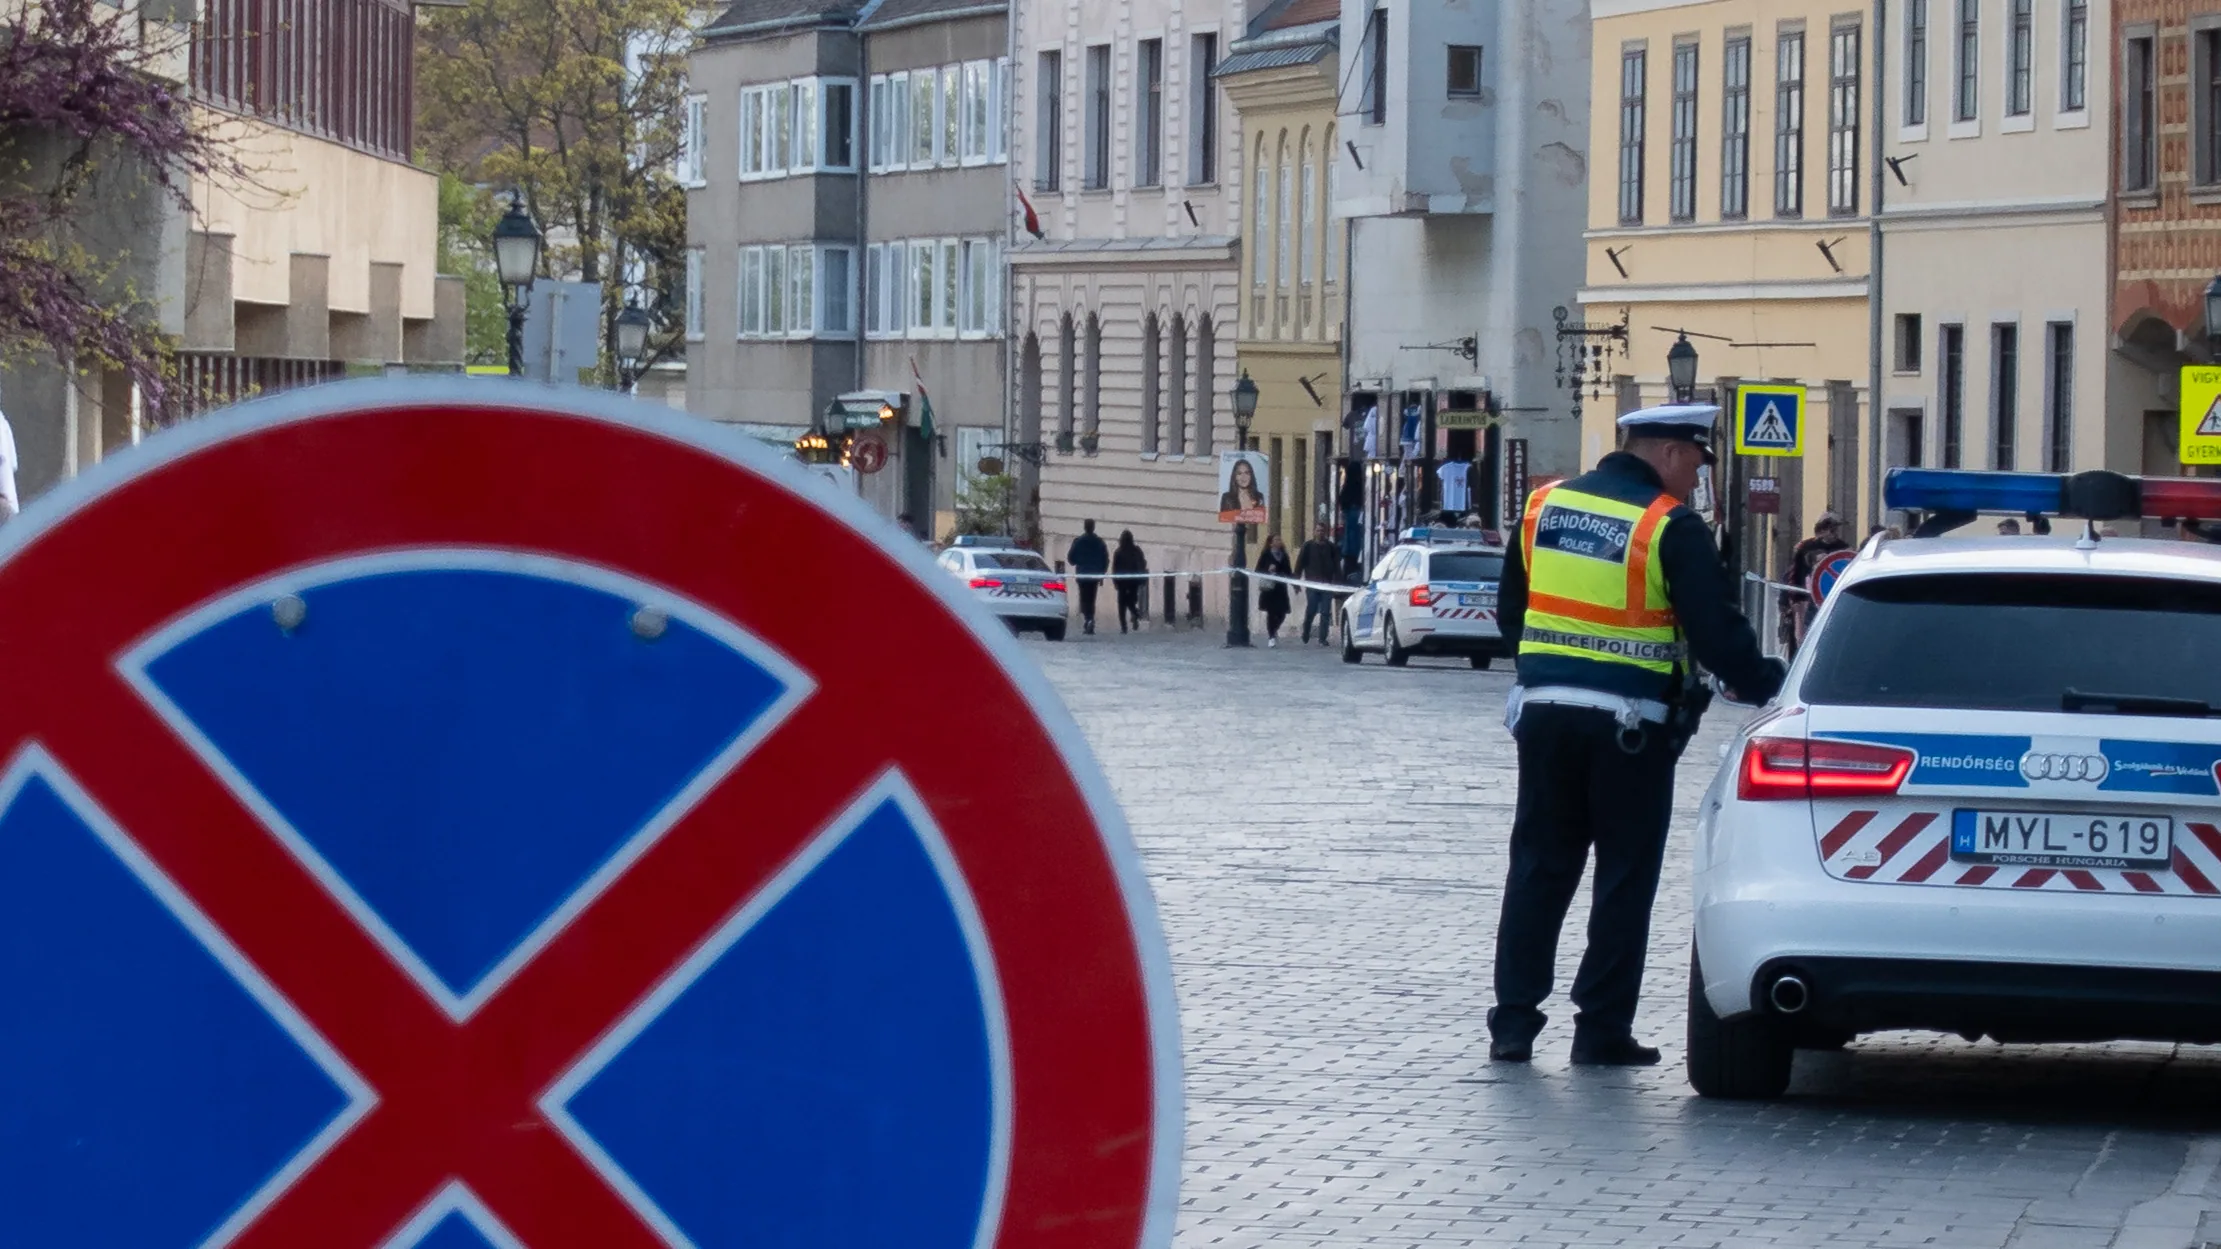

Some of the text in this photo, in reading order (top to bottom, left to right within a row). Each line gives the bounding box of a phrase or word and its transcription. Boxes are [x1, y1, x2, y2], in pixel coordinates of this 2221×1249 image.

[1540, 514, 1628, 548] RENDŐRSÉG
[1558, 536, 1596, 554] POLICE
[1920, 754, 2016, 772] RENDŐRSÉG
[1959, 835, 1971, 848] H
[1983, 815, 2160, 856] MYL-619
[1991, 854, 2129, 868] PORSCHE HUNGARIA
